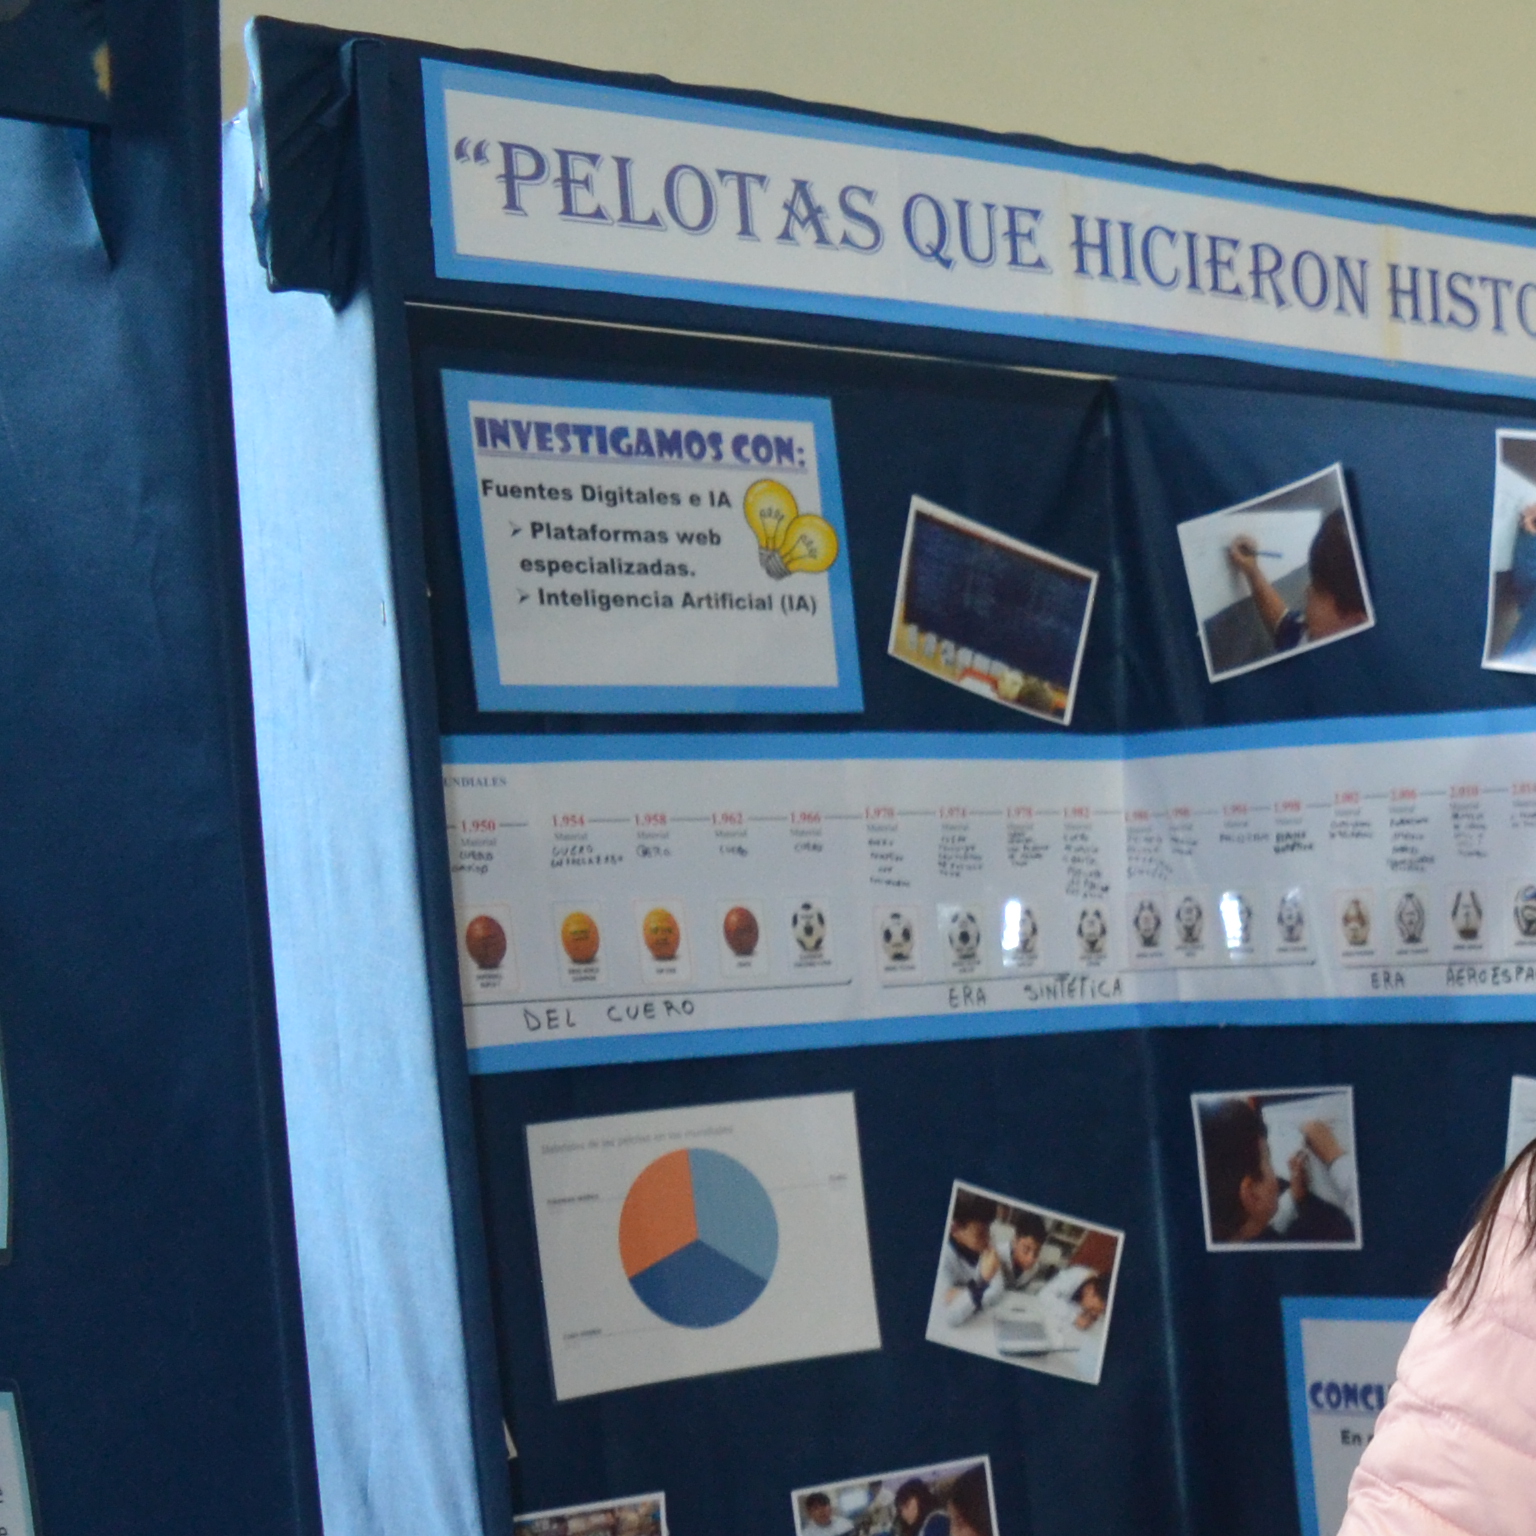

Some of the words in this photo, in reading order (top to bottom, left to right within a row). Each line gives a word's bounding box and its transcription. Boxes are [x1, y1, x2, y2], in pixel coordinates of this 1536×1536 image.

[902, 191, 1053, 275] QUE
[1070, 213, 1371, 319] HICIERON
[474, 415, 724, 462] INVESTIGAMOS
[732, 433, 807, 467] CON:
[482, 479, 572, 502] Fuentes
[580, 484, 680, 508] Digitales
[689, 493, 701, 507] e
[709, 490, 731, 508] IA
[530, 521, 668, 546] Plataformas
[676, 525, 721, 546] web
[520, 554, 695, 580] especializadas.
[538, 588, 673, 614] Inteligencia
[681, 592, 772, 612] Artificial
[780, 593, 817, 615] (IA)
[1371, 971, 1405, 990] ERA
[949, 986, 987, 1008] ERA
[607, 1000, 695, 1022] CUERO
